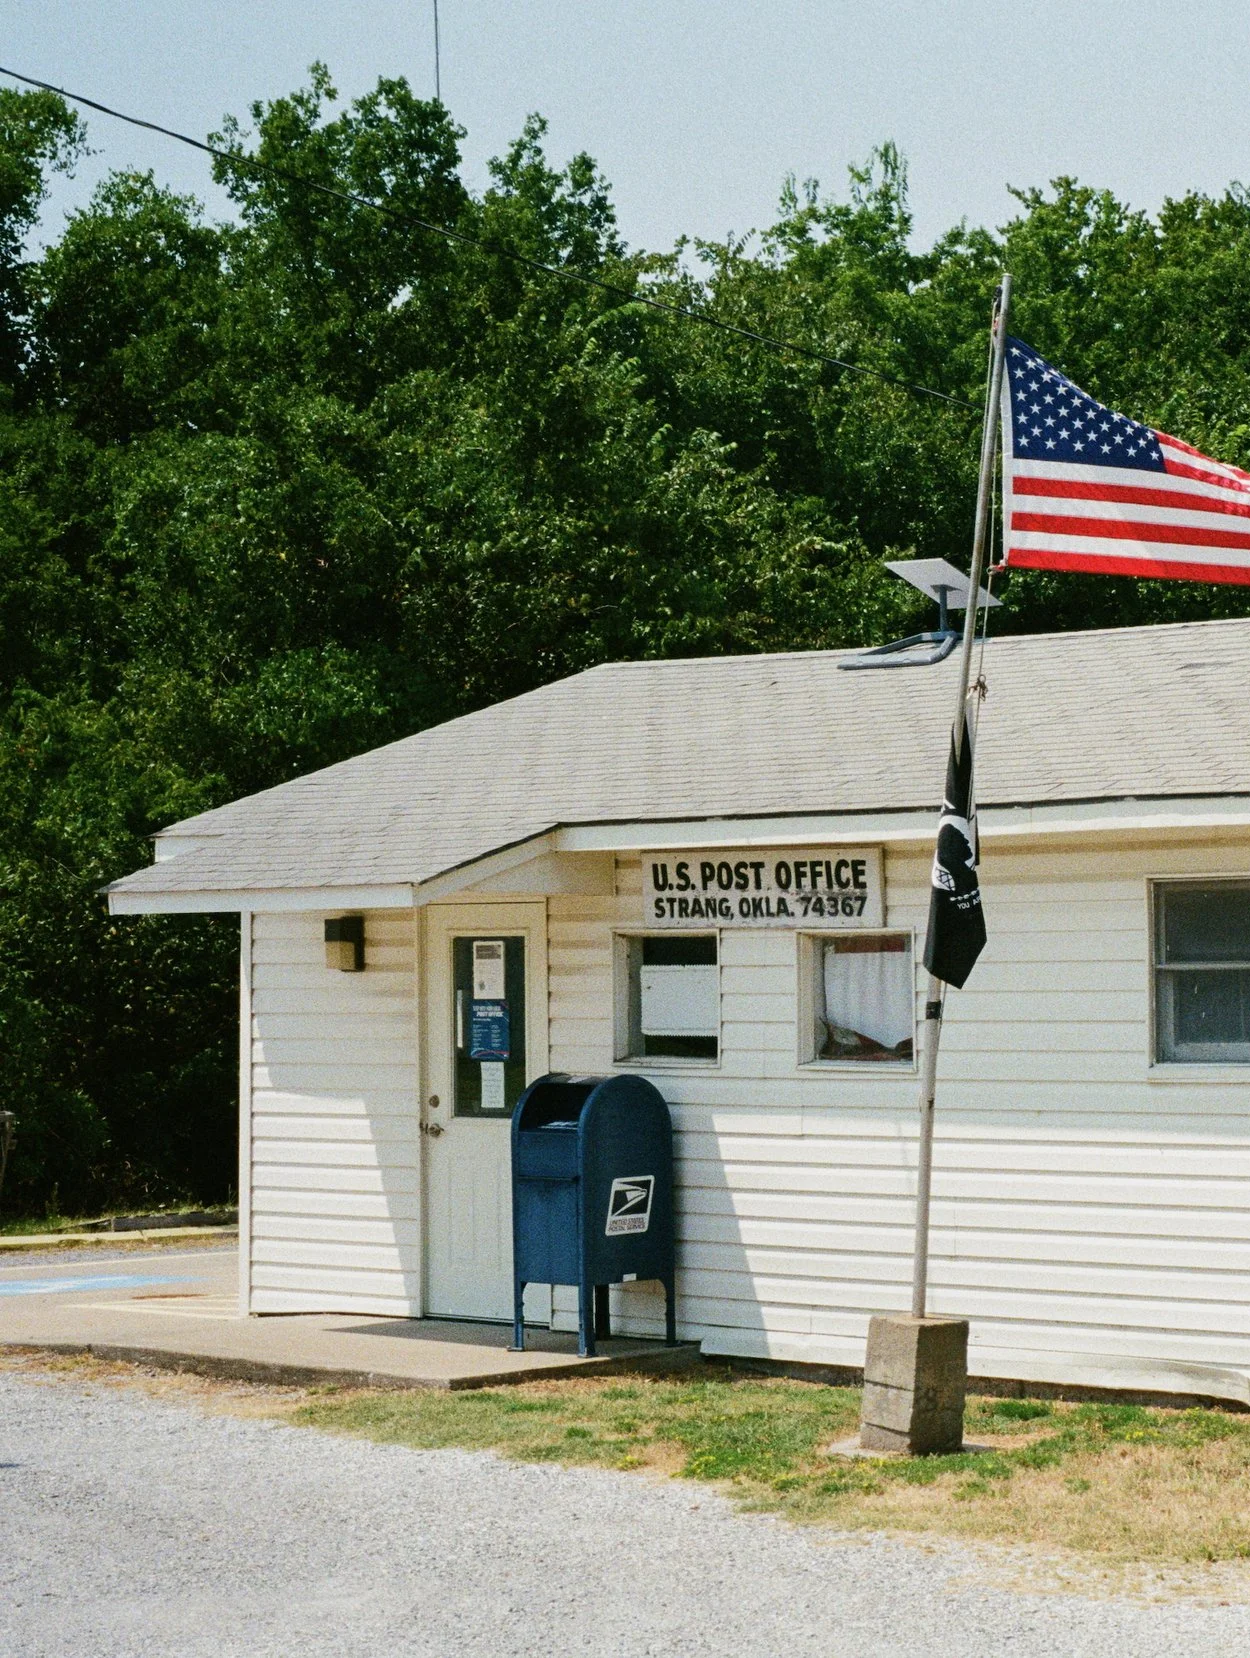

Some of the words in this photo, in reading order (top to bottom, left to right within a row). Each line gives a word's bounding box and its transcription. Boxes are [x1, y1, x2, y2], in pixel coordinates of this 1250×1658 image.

[652, 862, 696, 892] U.S.
[700, 861, 765, 891] POST
[775, 859, 867, 890] OFFICE
[655, 897, 734, 920] STRANG,
[738, 897, 795, 918] OKLA.
[798, 896, 867, 917] 74367
